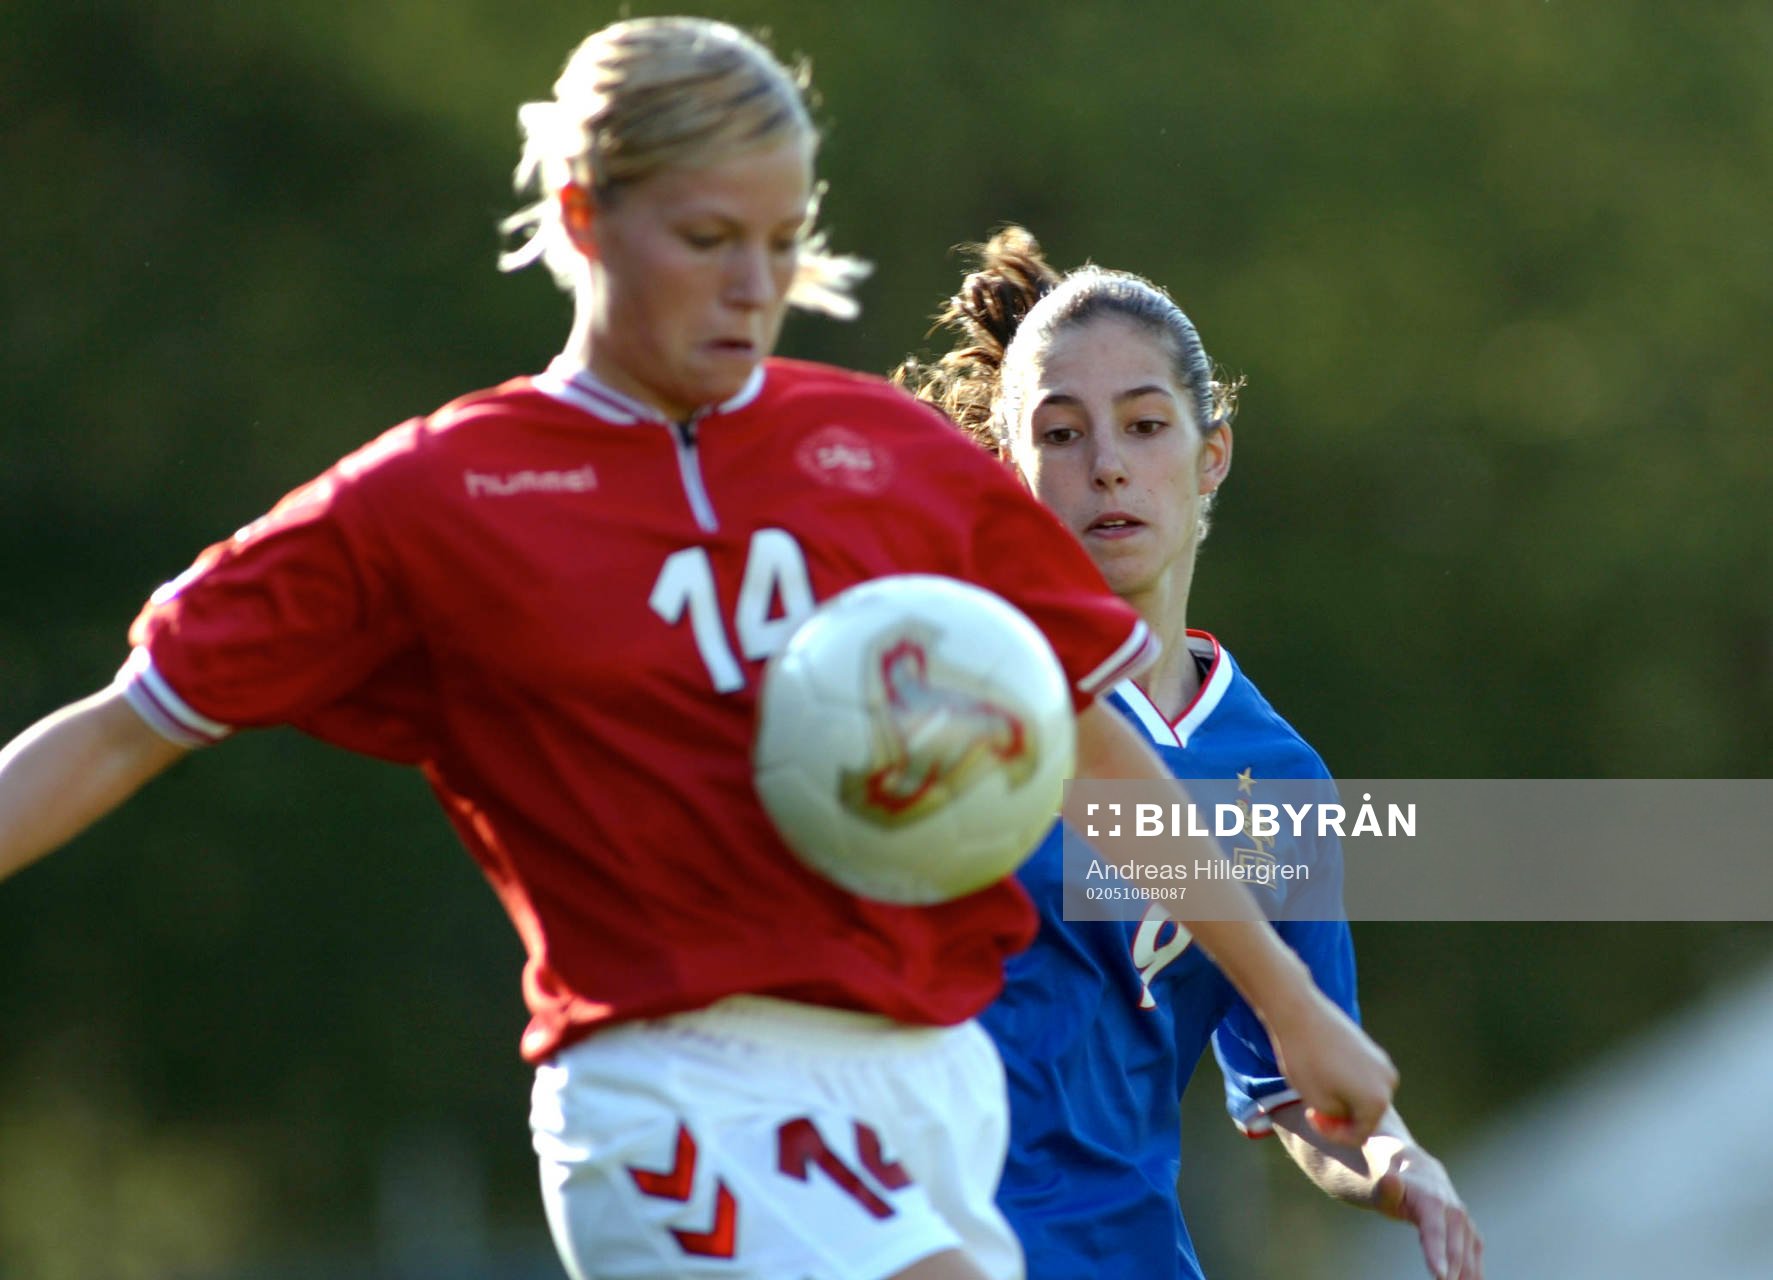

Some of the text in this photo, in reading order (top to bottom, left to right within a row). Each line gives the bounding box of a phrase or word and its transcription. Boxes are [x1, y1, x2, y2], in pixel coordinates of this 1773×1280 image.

[463, 464, 597, 497] hummel
[648, 527, 818, 693] 14
[1129, 901, 1193, 1011] 9
